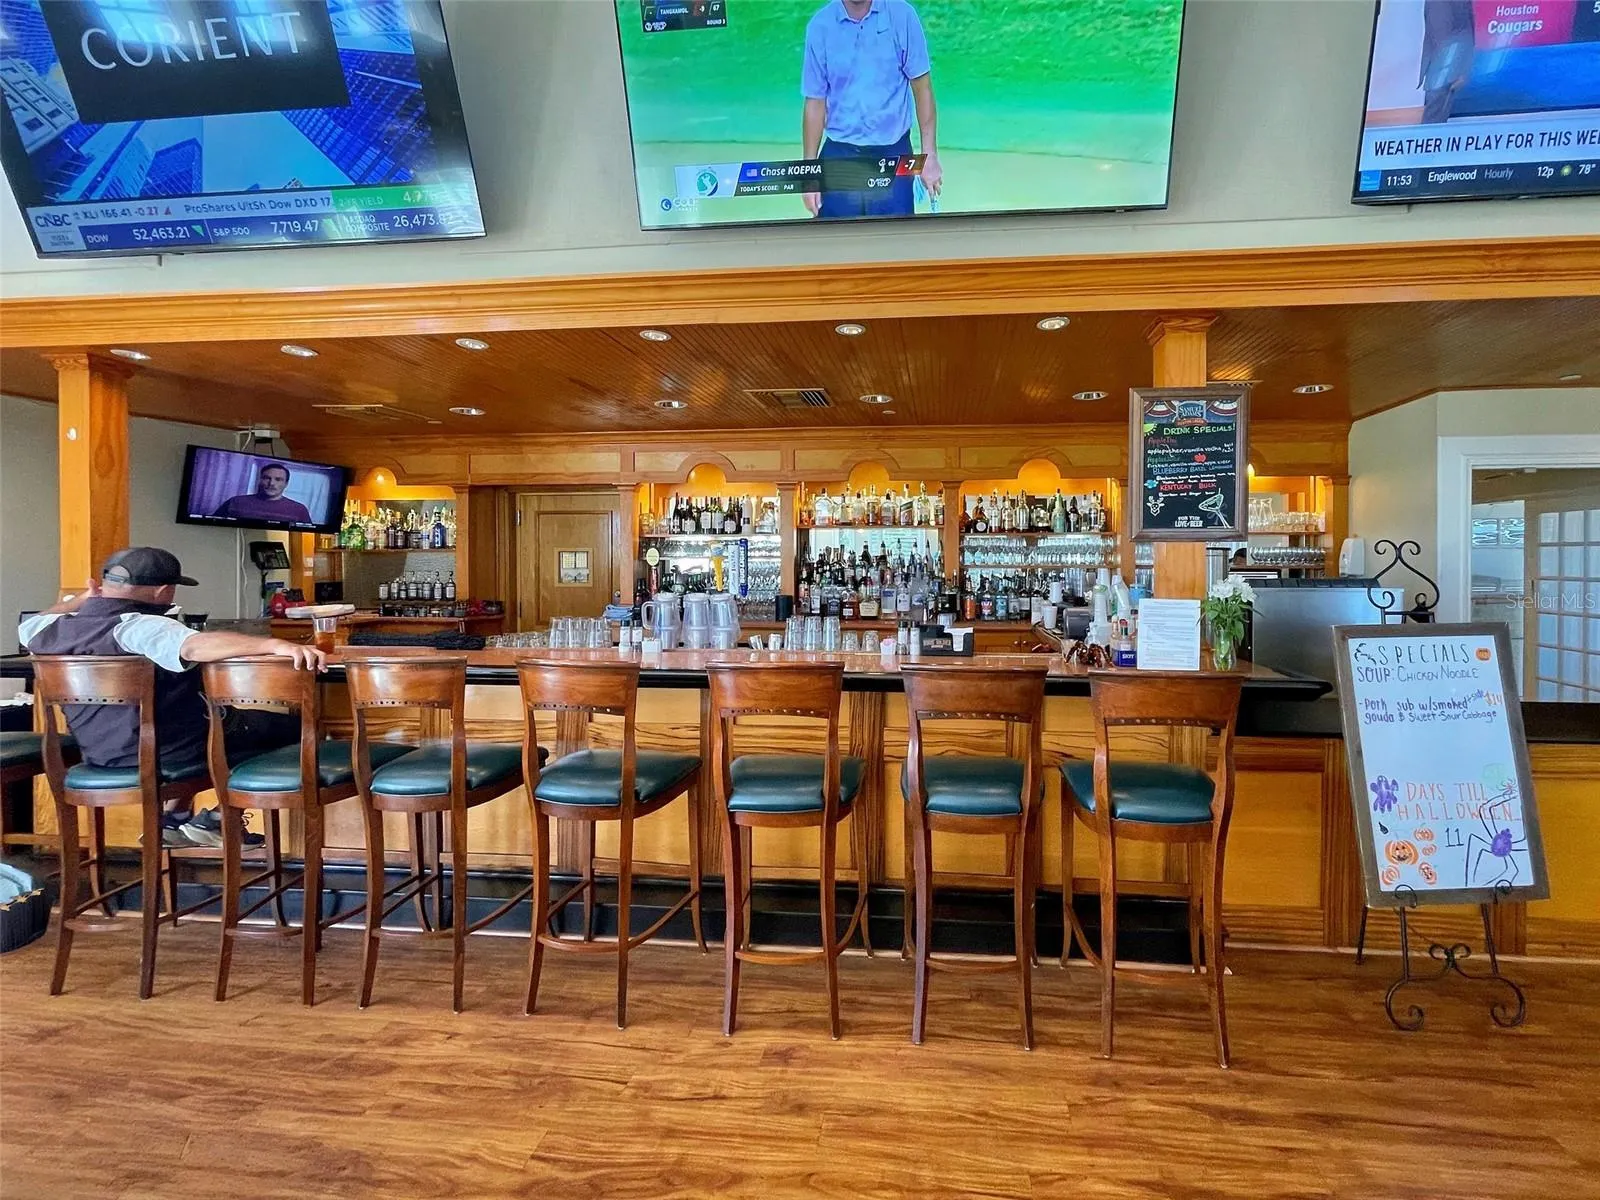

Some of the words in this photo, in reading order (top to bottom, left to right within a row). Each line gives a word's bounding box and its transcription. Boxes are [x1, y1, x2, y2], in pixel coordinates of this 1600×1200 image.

[1496, 5, 1539, 16] Houston
[1487, 20, 1543, 36] Cougars
[81, 12, 300, 70] CORIENT
[1374, 138, 1442, 156] WEATHER
[1446, 136, 1461, 152] IN
[1465, 134, 1502, 151] PLAY
[1506, 133, 1534, 149] FOR
[1539, 131, 1572, 147] THIS
[760, 167, 786, 177] Chase
[788, 165, 822, 176] KOEPKA
[1386, 175, 1412, 186] 11:53
[1428, 171, 1477, 183] Englewood
[1484, 168, 1513, 181] Hourly
[1537, 166, 1554, 178] 12p
[184, 201, 236, 214] ProShares
[269, 199, 292, 210] Dow
[35, 213, 72, 228] CNBC
[86, 234, 109, 244] DOW
[133, 227, 191, 242] 52,463.21
[213, 228, 231, 237] S&P
[232, 227, 250, 236] 500
[270, 219, 318, 236] 7,719.47
[1163, 427, 1190, 435] DRINK
[1153, 467, 1187, 475] BLUEBERRY
[1160, 483, 1192, 491] KENTUCKY
[1378, 643, 1470, 666] SPECIALS
[1357, 666, 1394, 683] SOUP:
[1397, 698, 1415, 711] sub
[1364, 712, 1395, 725] gouda
[1406, 782, 1445, 802] DAYS
[1453, 782, 1488, 801] TILL
[1445, 827, 1465, 848] 11
